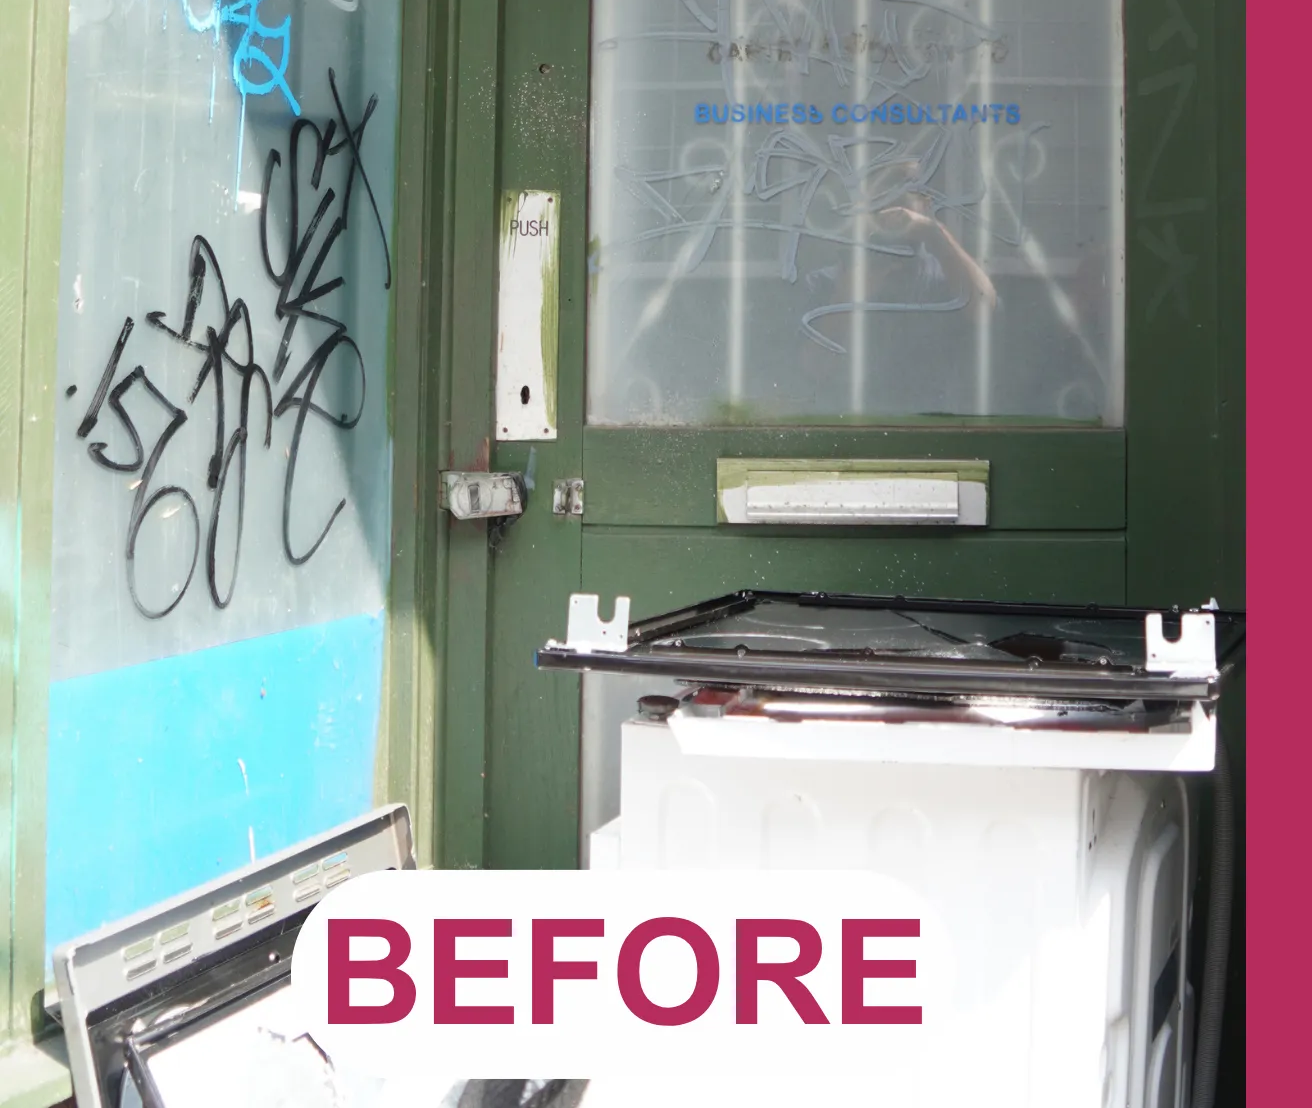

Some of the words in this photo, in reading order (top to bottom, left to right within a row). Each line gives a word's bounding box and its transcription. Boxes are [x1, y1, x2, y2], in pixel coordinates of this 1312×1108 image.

[694, 102, 824, 124] BUSINESS
[830, 102, 1021, 124] CONSULTANTS
[510, 219, 549, 237] PUSH
